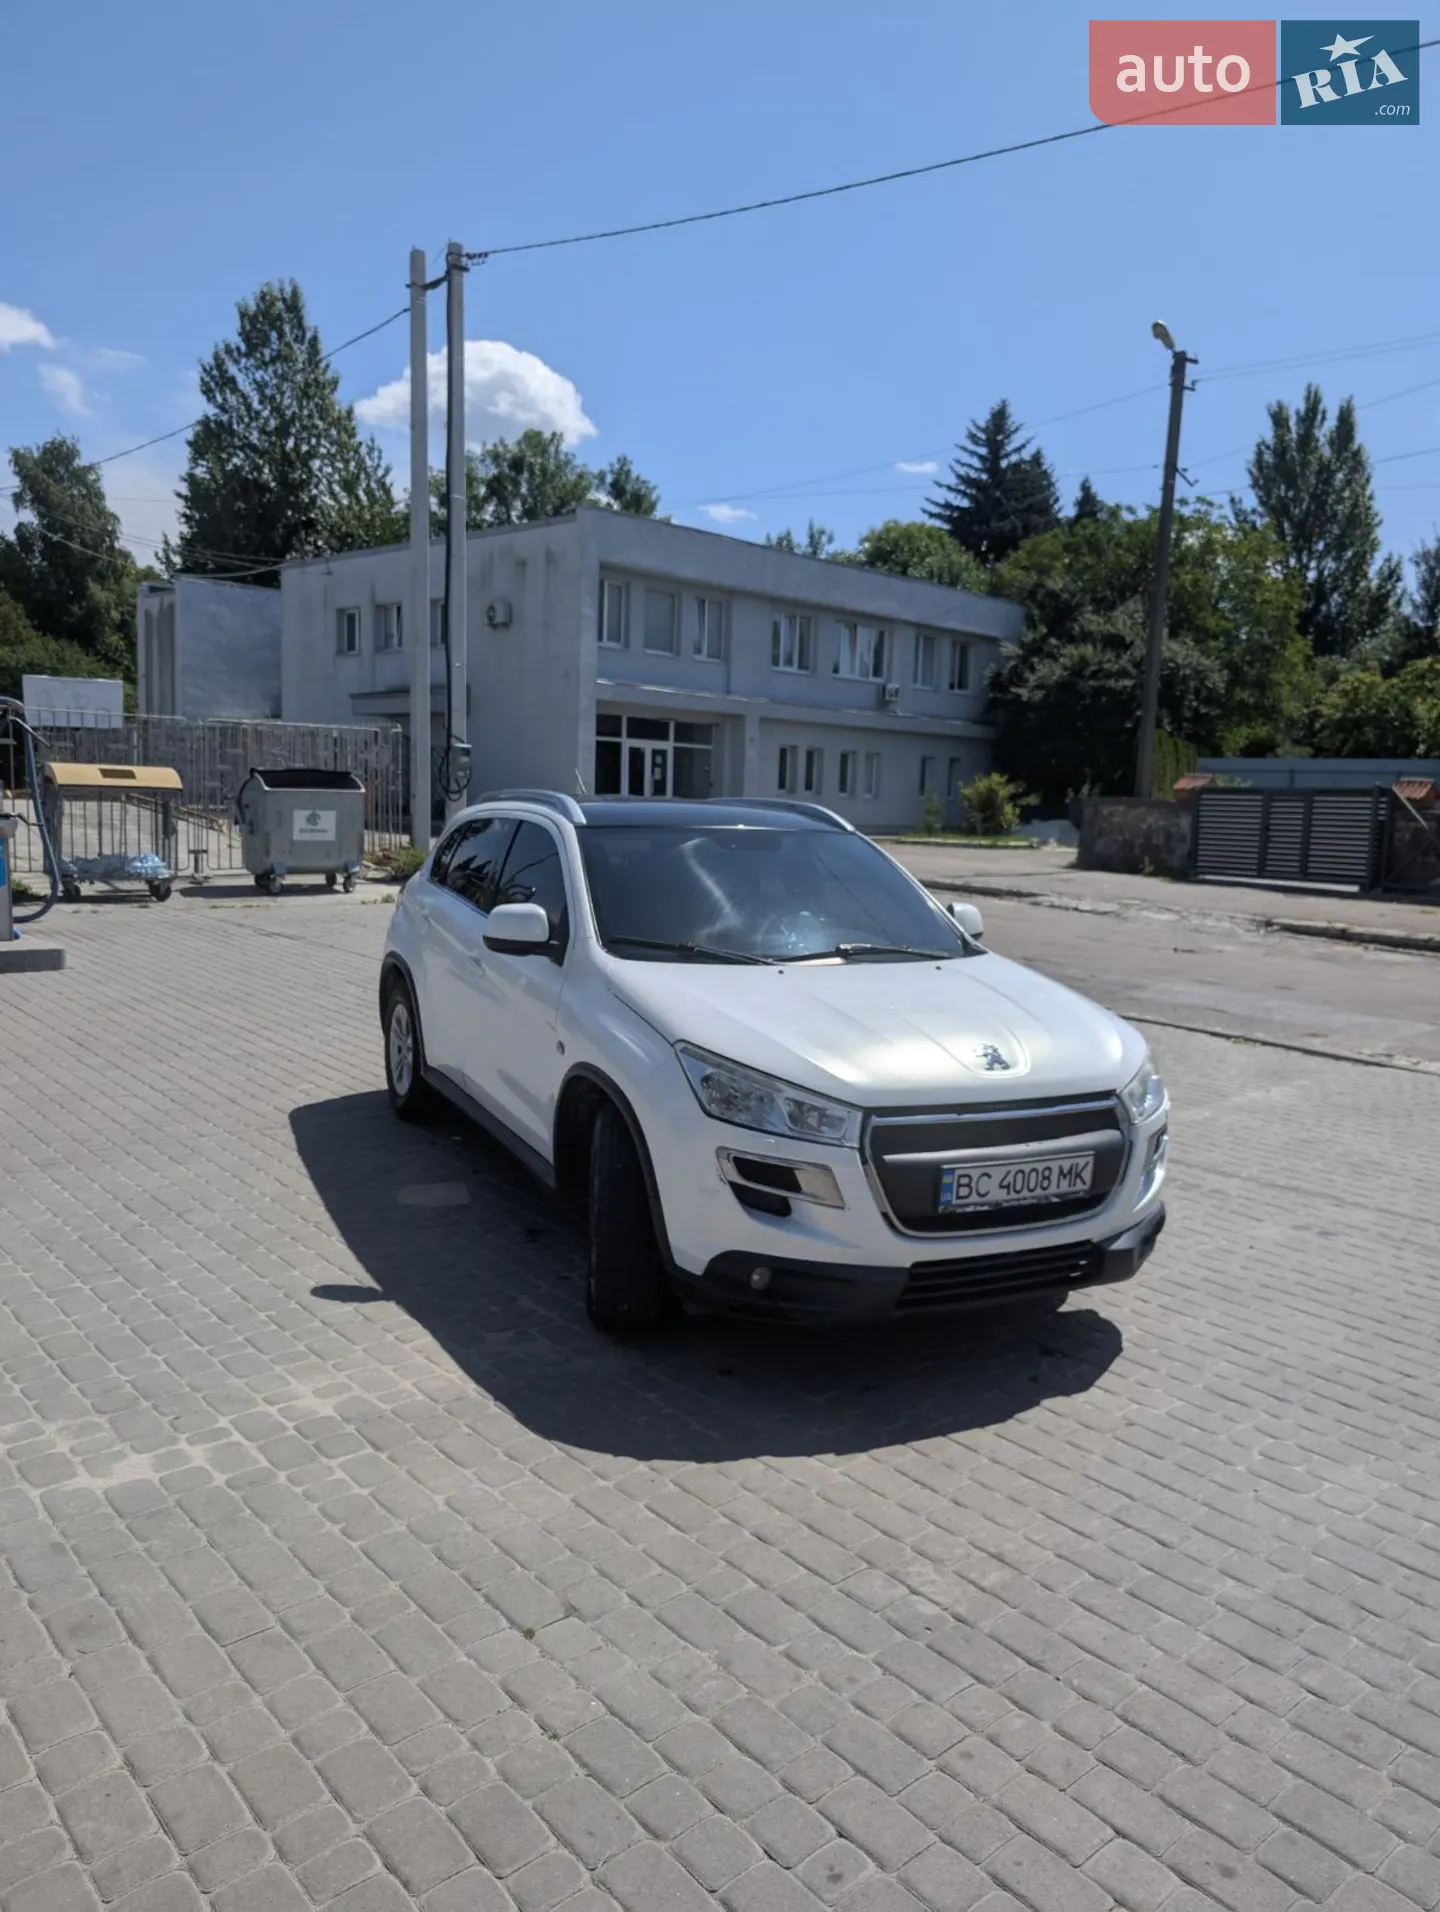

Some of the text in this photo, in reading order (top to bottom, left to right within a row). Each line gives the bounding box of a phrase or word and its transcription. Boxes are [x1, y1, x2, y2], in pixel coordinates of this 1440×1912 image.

[956, 1160, 1090, 1200] BC 4008 MK
